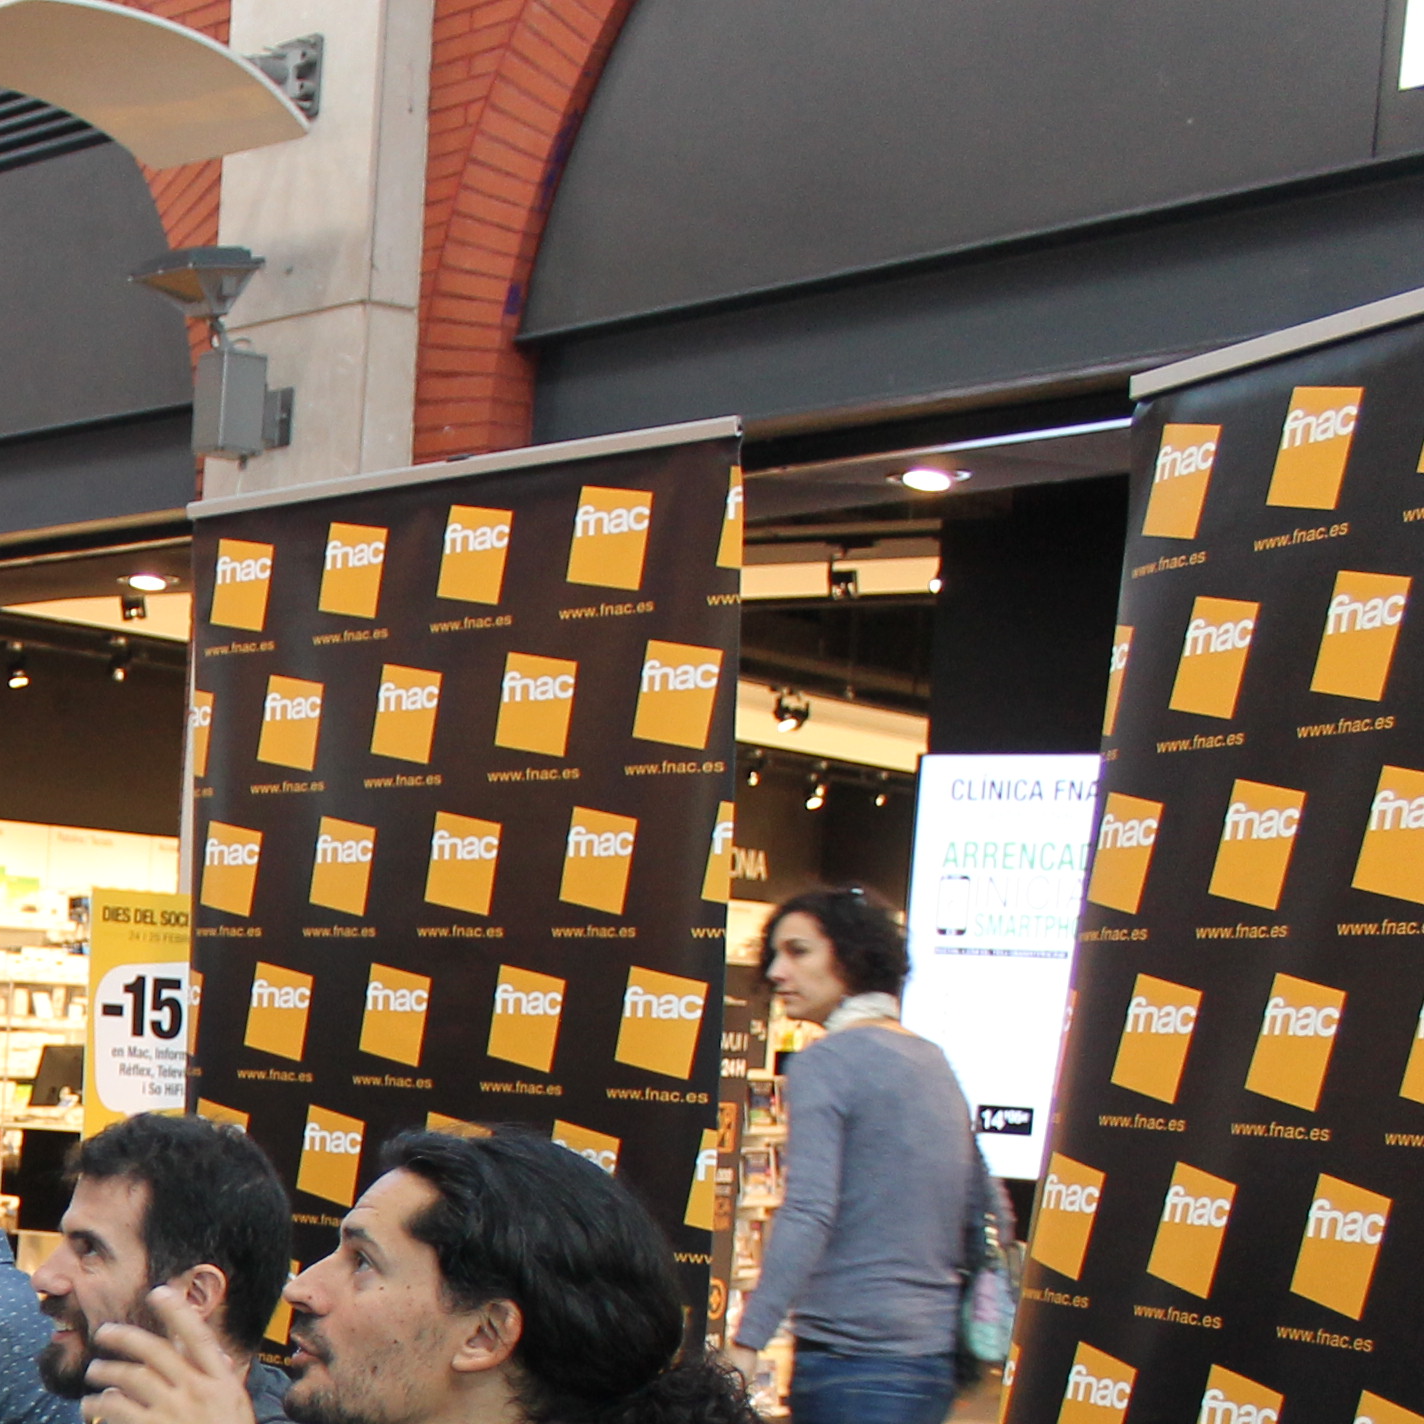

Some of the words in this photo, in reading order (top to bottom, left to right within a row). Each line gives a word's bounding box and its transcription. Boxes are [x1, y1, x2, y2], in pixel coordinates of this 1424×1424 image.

[1281, 403, 1357, 450] fnac
[1154, 439, 1216, 484] fnac
[573, 504, 651, 539] fnac
[1253, 521, 1350, 553] www.fnac.es
[443, 521, 511, 555] fnac
[215, 554, 273, 586] fnac
[324, 539, 386, 571] fnac
[428, 615, 517, 635] www.fnac.es
[558, 600, 657, 624] www.fnac.es
[1324, 593, 1408, 635] fnac
[311, 627, 393, 647] www.fnac.es
[1182, 614, 1256, 657] fnac
[501, 670, 576, 703] fnac
[640, 658, 721, 693] fnac
[263, 691, 322, 722] fnac
[377, 681, 440, 713] fnac
[1156, 730, 1245, 756] www.fnac.es
[1296, 714, 1395, 740] www.fnac.es
[362, 773, 444, 789] www.fnac.es
[486, 767, 582, 784] www.fnac.es
[624, 759, 726, 777] www.fnac.es
[951, 773, 1044, 802] CLÍNICA
[1053, 778, 1099, 802] FNA
[1221, 797, 1302, 841] fnac
[1367, 788, 1424, 831] fna
[315, 829, 374, 865] fnac
[430, 828, 500, 862] fnac
[566, 825, 635, 858] fnac
[1097, 813, 1160, 849] fnac
[204, 836, 261, 868] fnac
[102, 905, 131, 924] DIES
[133, 907, 157, 926] DEL
[417, 923, 506, 939] www.fnac.es
[550, 924, 638, 939] www.fnac.es
[302, 926, 377, 939] www.fnac.es
[1195, 922, 1290, 942] www.fnac.es
[250, 978, 311, 1010] fnac
[365, 980, 429, 1013] fnac
[494, 982, 563, 1016] fnac
[622, 985, 705, 1021] fnac
[1124, 995, 1198, 1035] fnac
[1260, 995, 1342, 1038] fnac
[111, 1047, 125, 1059] en
[127, 1045, 152, 1061] Mac,
[236, 1067, 315, 1083] www.fnac.es
[352, 1073, 434, 1090] www.fnac.es
[479, 1079, 564, 1097] www.fnac.es
[607, 1085, 710, 1105] www.fnac.es
[303, 1121, 363, 1155] fnac
[1099, 1114, 1187, 1133] www.fnac.es
[1231, 1121, 1333, 1142] www.fnac.es
[1041, 1172, 1102, 1215] fnac
[1161, 1181, 1232, 1228] fnac
[1305, 1197, 1387, 1245] fnac
[1132, 1303, 1224, 1330] www.fnac.es
[1275, 1325, 1375, 1354] www.fnac.es
[1065, 1362, 1132, 1410] fnac
